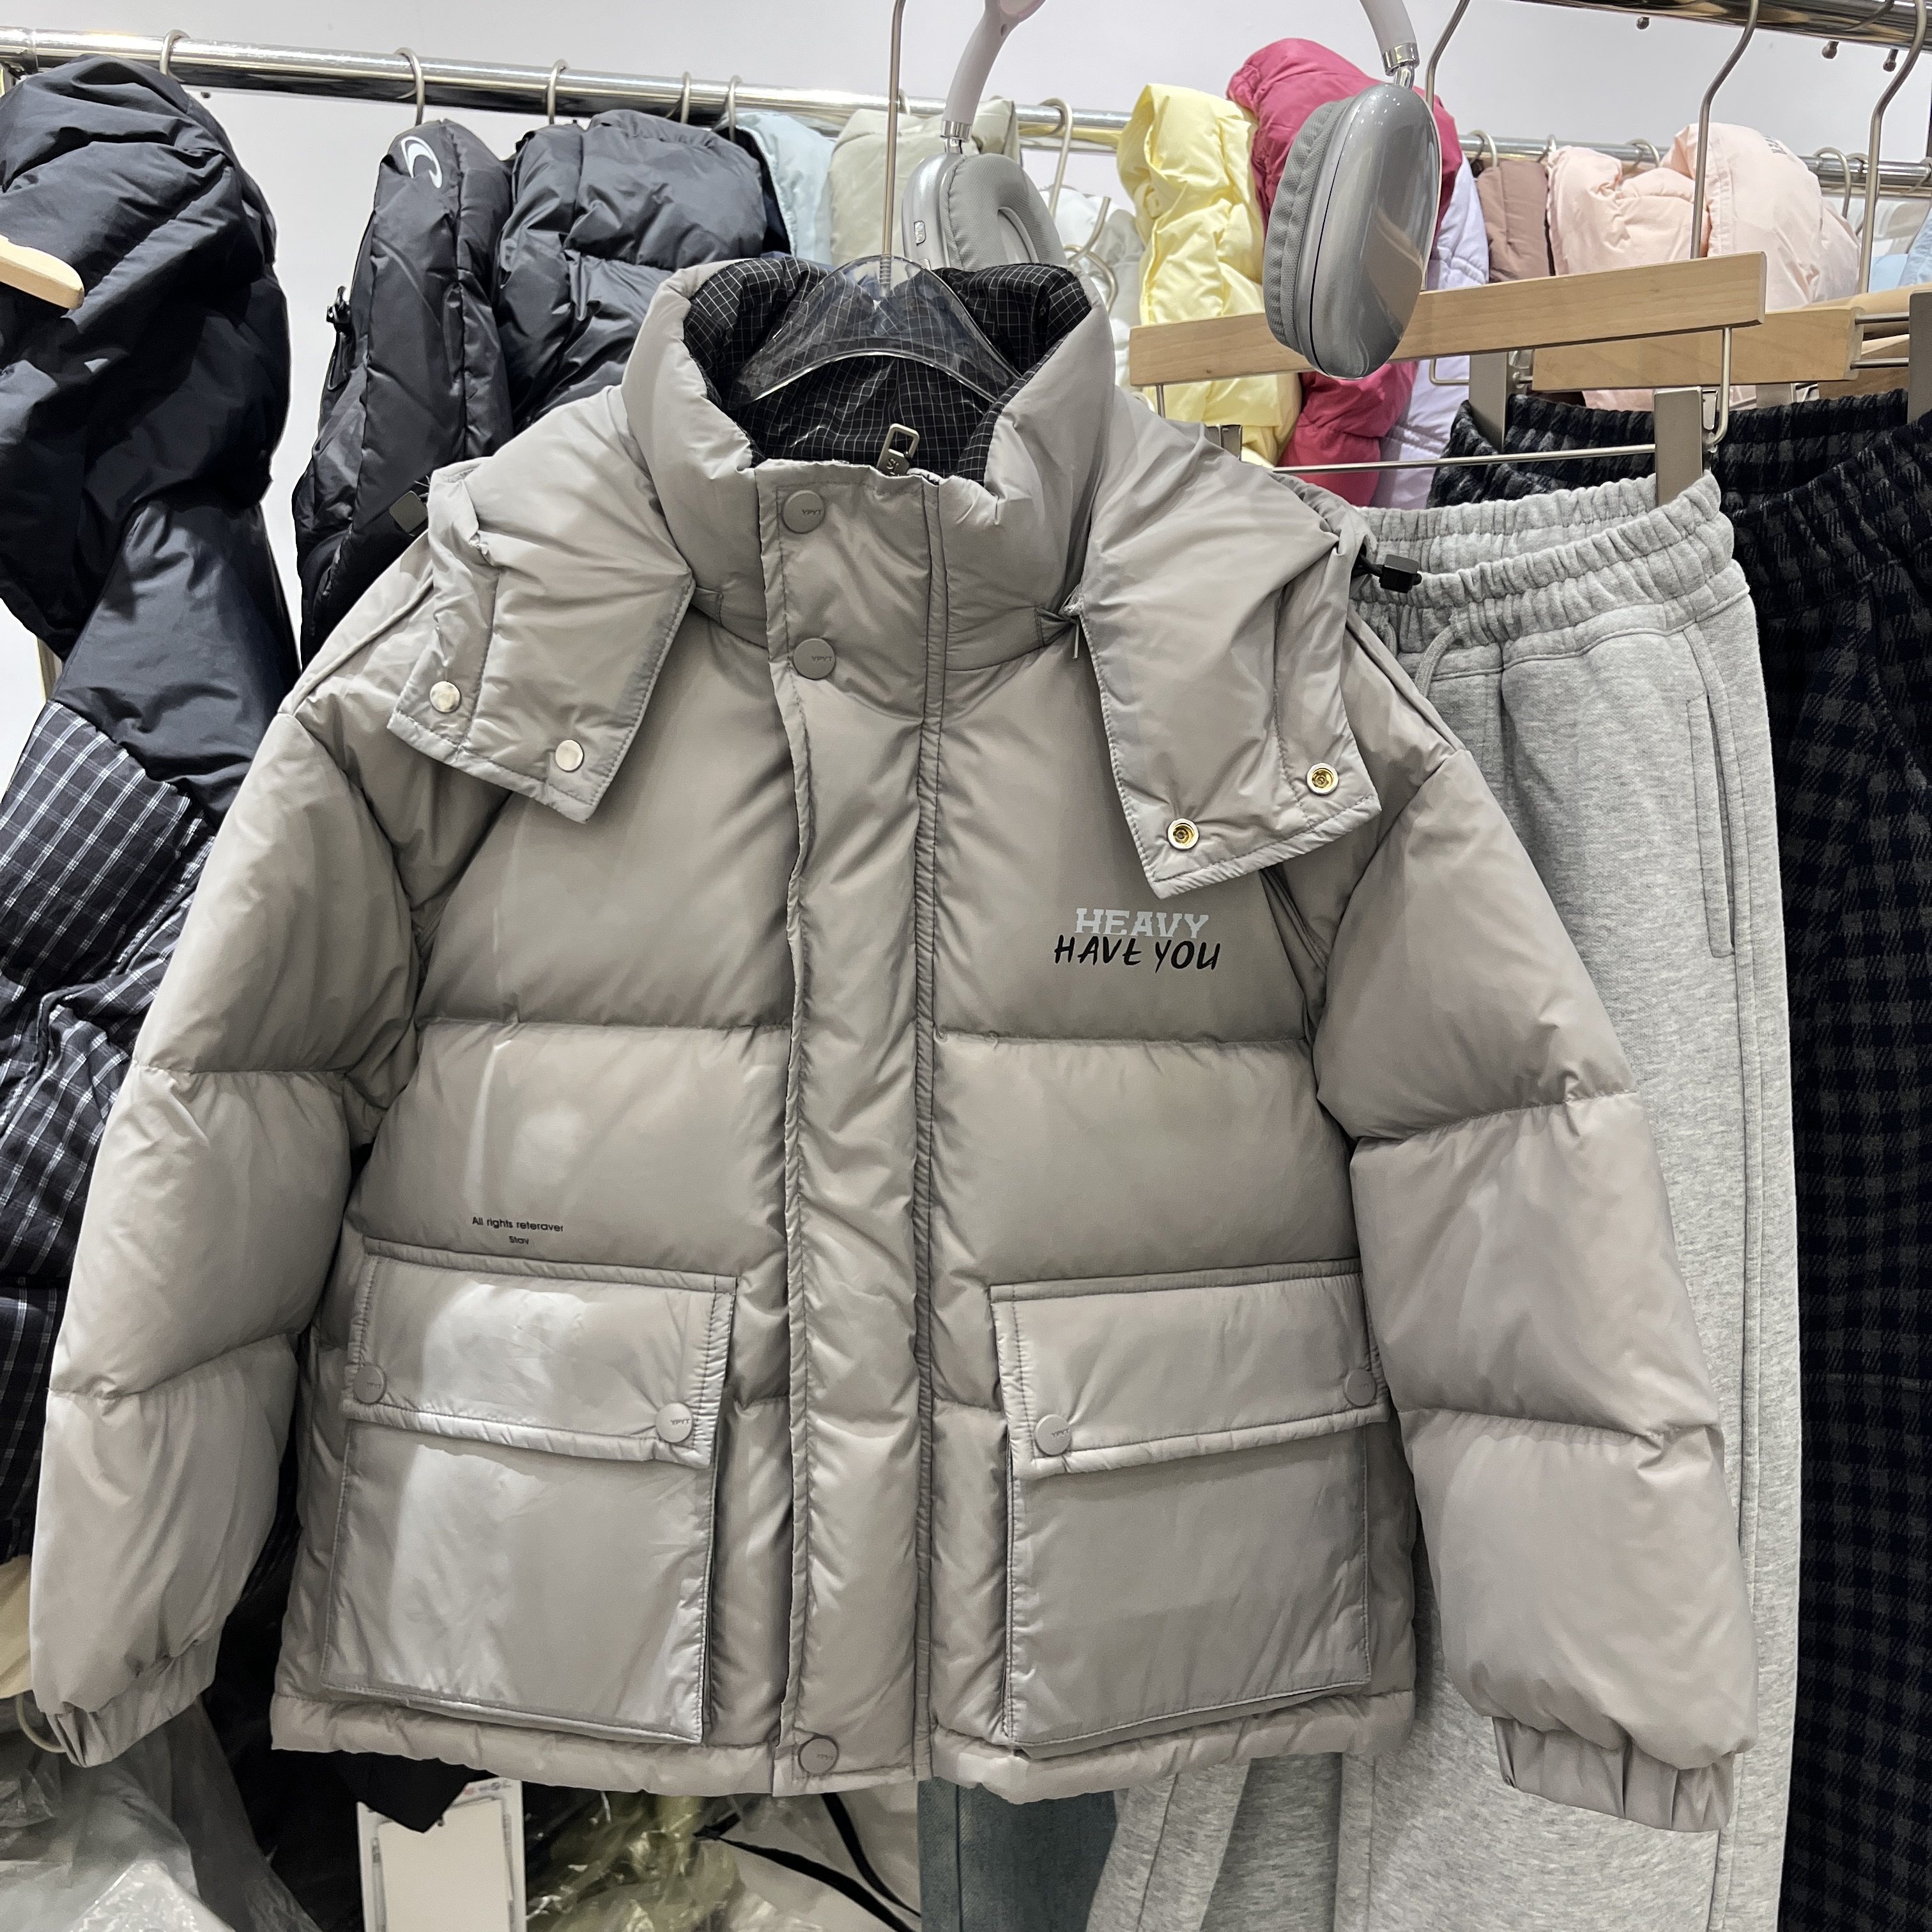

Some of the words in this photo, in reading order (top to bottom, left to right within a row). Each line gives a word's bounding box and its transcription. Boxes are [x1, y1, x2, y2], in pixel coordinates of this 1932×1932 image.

[1074, 908, 1209, 939] HEAVY
[1054, 935, 1142, 965] HAVE
[1155, 939, 1221, 974] YOU
[472, 1216, 484, 1226] All
[487, 1218, 513, 1229] rights
